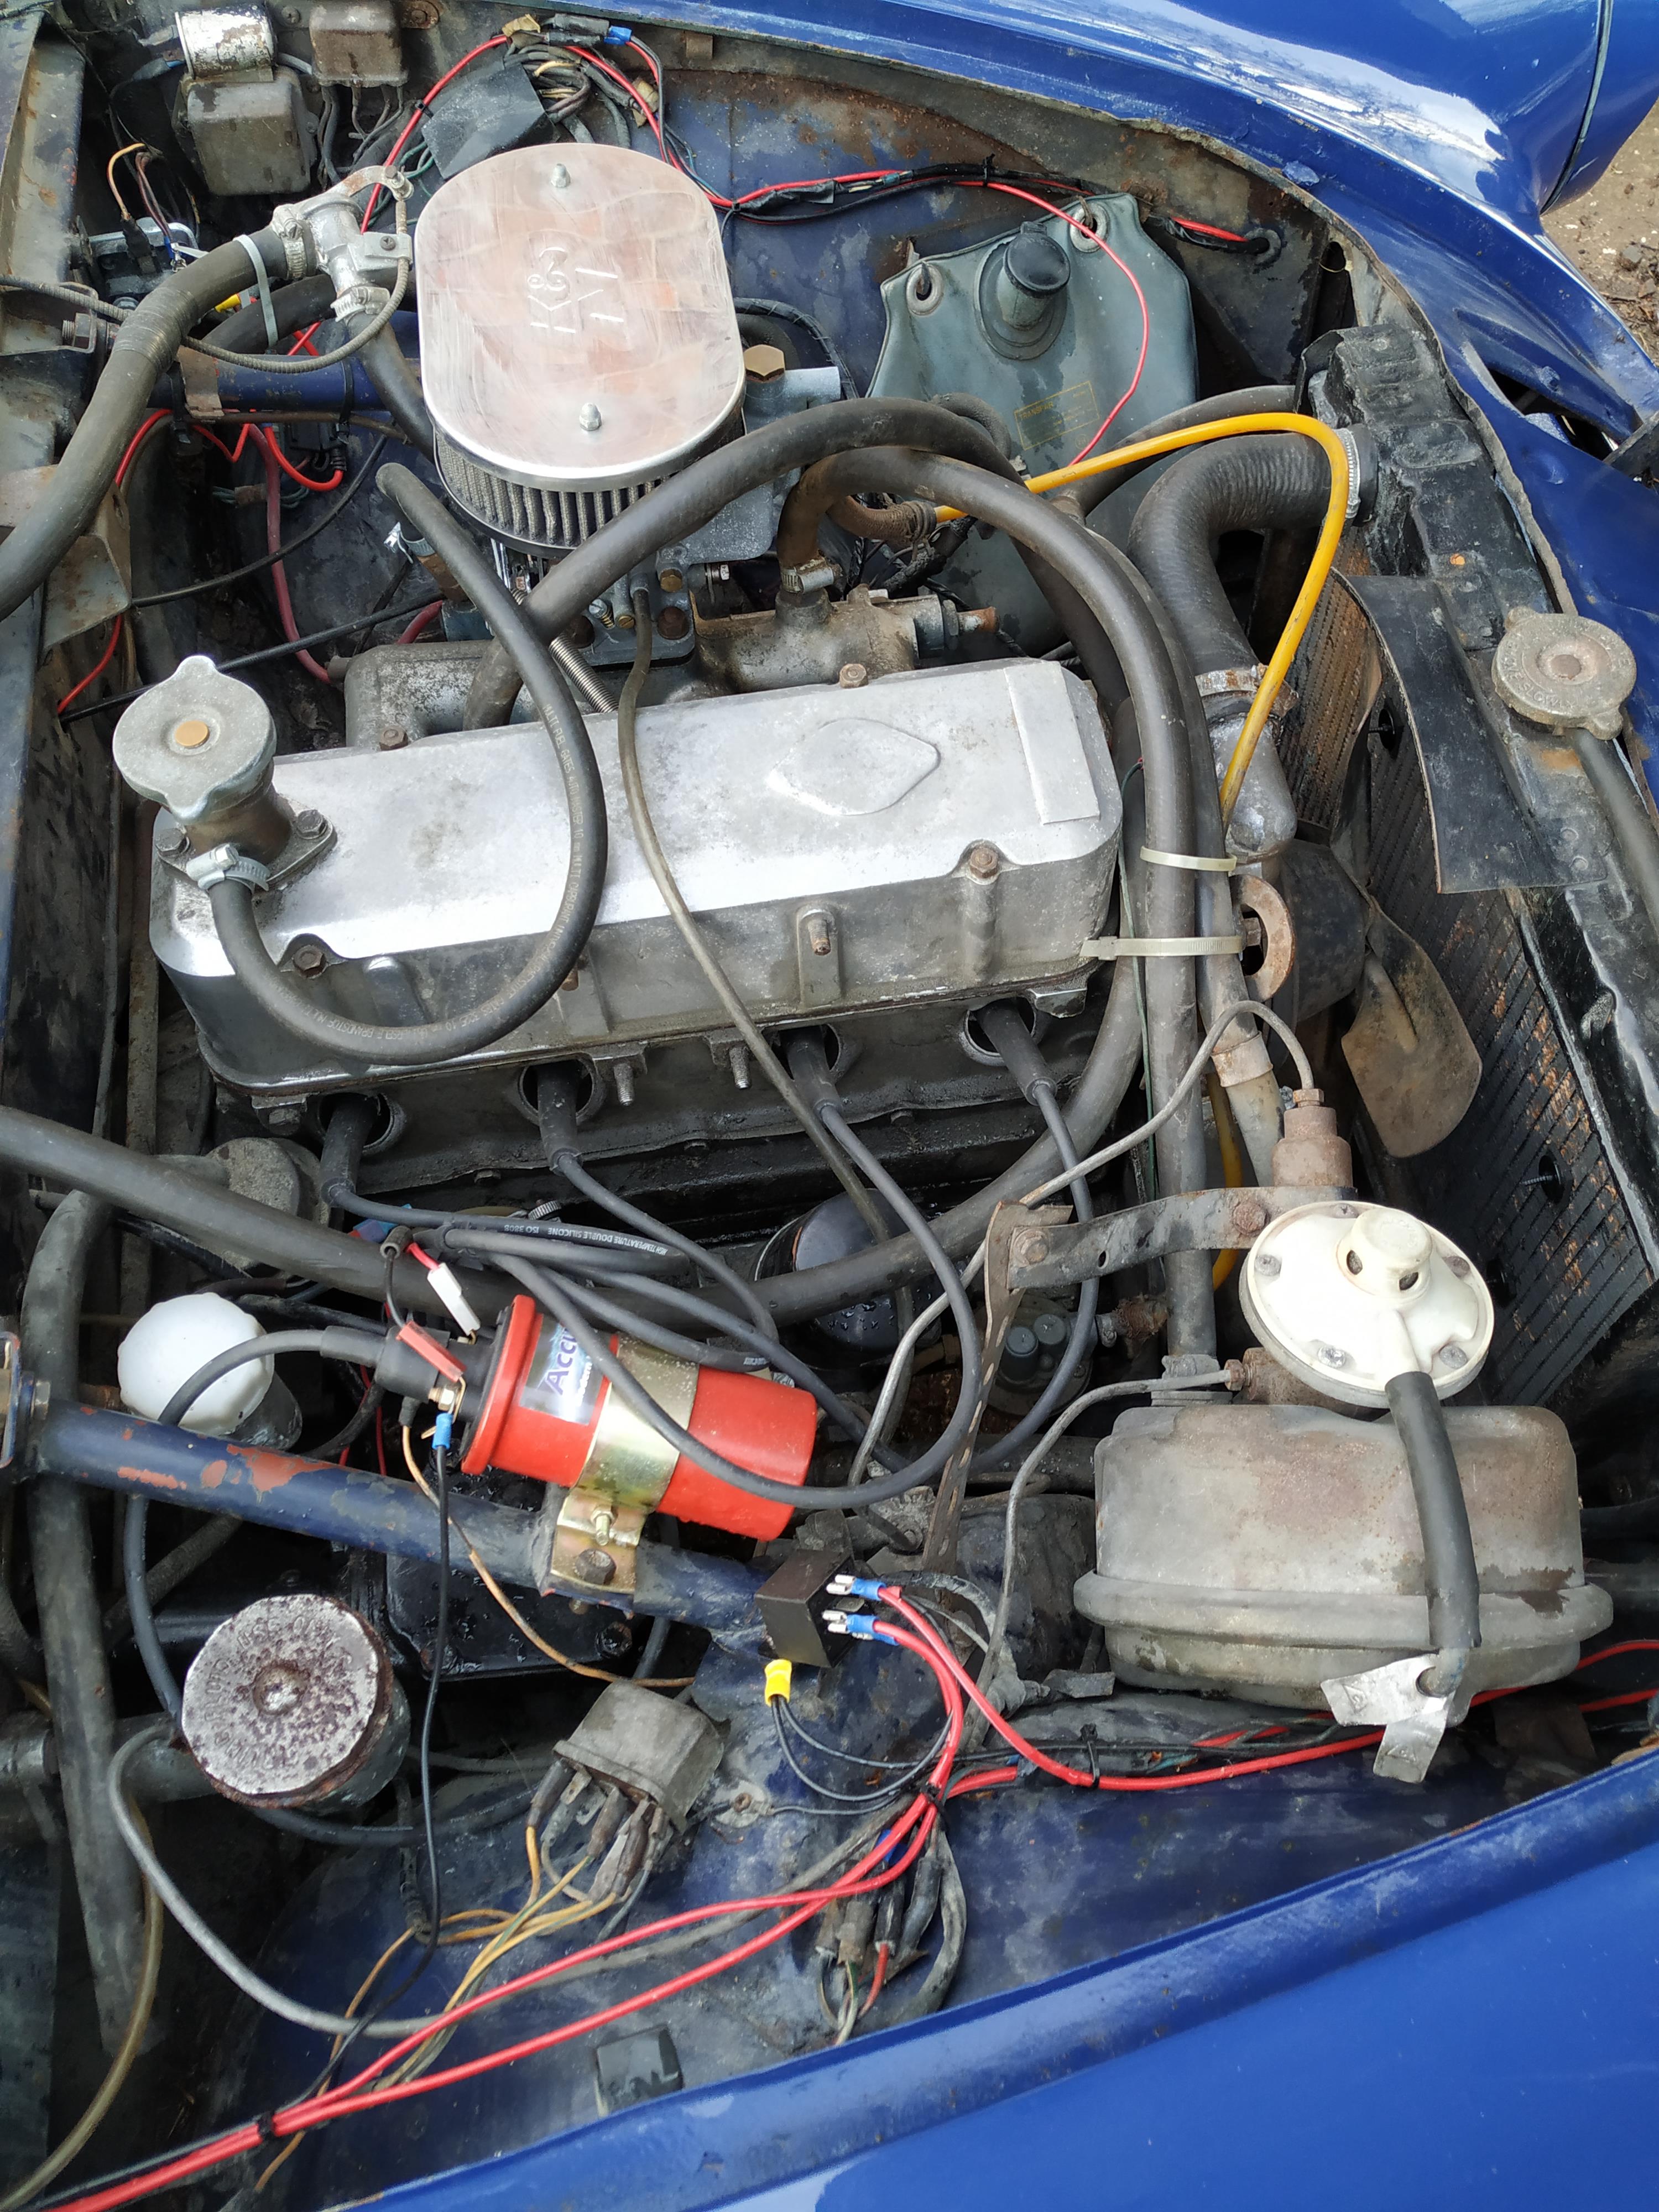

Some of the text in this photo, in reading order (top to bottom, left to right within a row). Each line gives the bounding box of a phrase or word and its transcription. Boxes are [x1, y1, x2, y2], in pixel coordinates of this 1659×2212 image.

[552, 727, 566, 749] FUEL
[560, 749, 575, 773] GATES
[573, 828, 583, 839] 10
[526, 1225, 540, 1234] ISO
[547, 1227, 582, 1238] SILICONE
[583, 1231, 613, 1243] DOUBLE
[614, 1237, 656, 1253] TEMPERATURE
